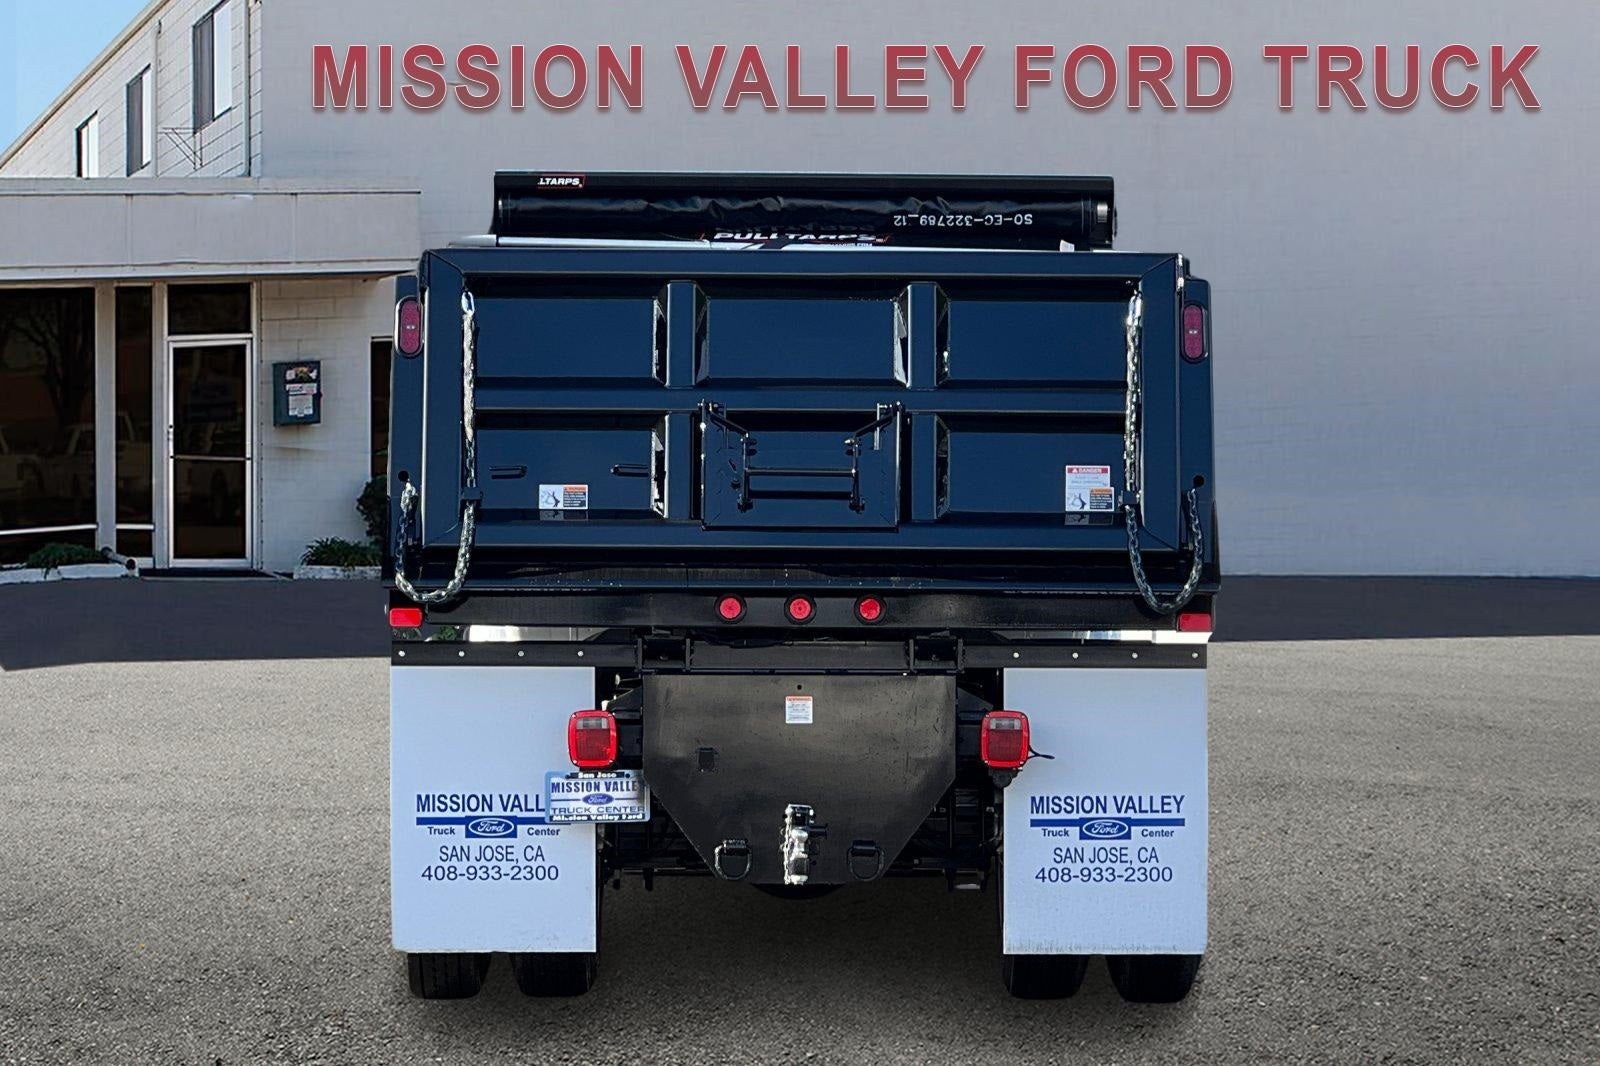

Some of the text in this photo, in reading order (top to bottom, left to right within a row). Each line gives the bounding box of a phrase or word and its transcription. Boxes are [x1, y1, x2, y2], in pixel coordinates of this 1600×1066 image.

[538, 177, 580, 186] LTARPS
[893, 213, 1033, 227] SO-EC-322789_12
[551, 781, 641, 793] MISSION VALLE
[416, 794, 546, 813] MISSION VALL
[1030, 795, 1186, 814] MISSION VALLEY
[591, 814, 620, 822] Valley
[428, 826, 560, 836] Truck Center
[477, 820, 505, 833] Ford
[1042, 828, 1174, 838] Truck Center
[1091, 821, 1119, 835] Ford
[439, 845, 546, 864] SAN JOSE, CA
[1053, 846, 1159, 866] SAN JOSE, CA
[421, 865, 559, 881] 408-933-2300
[1035, 866, 1173, 883] 408-933-2300
